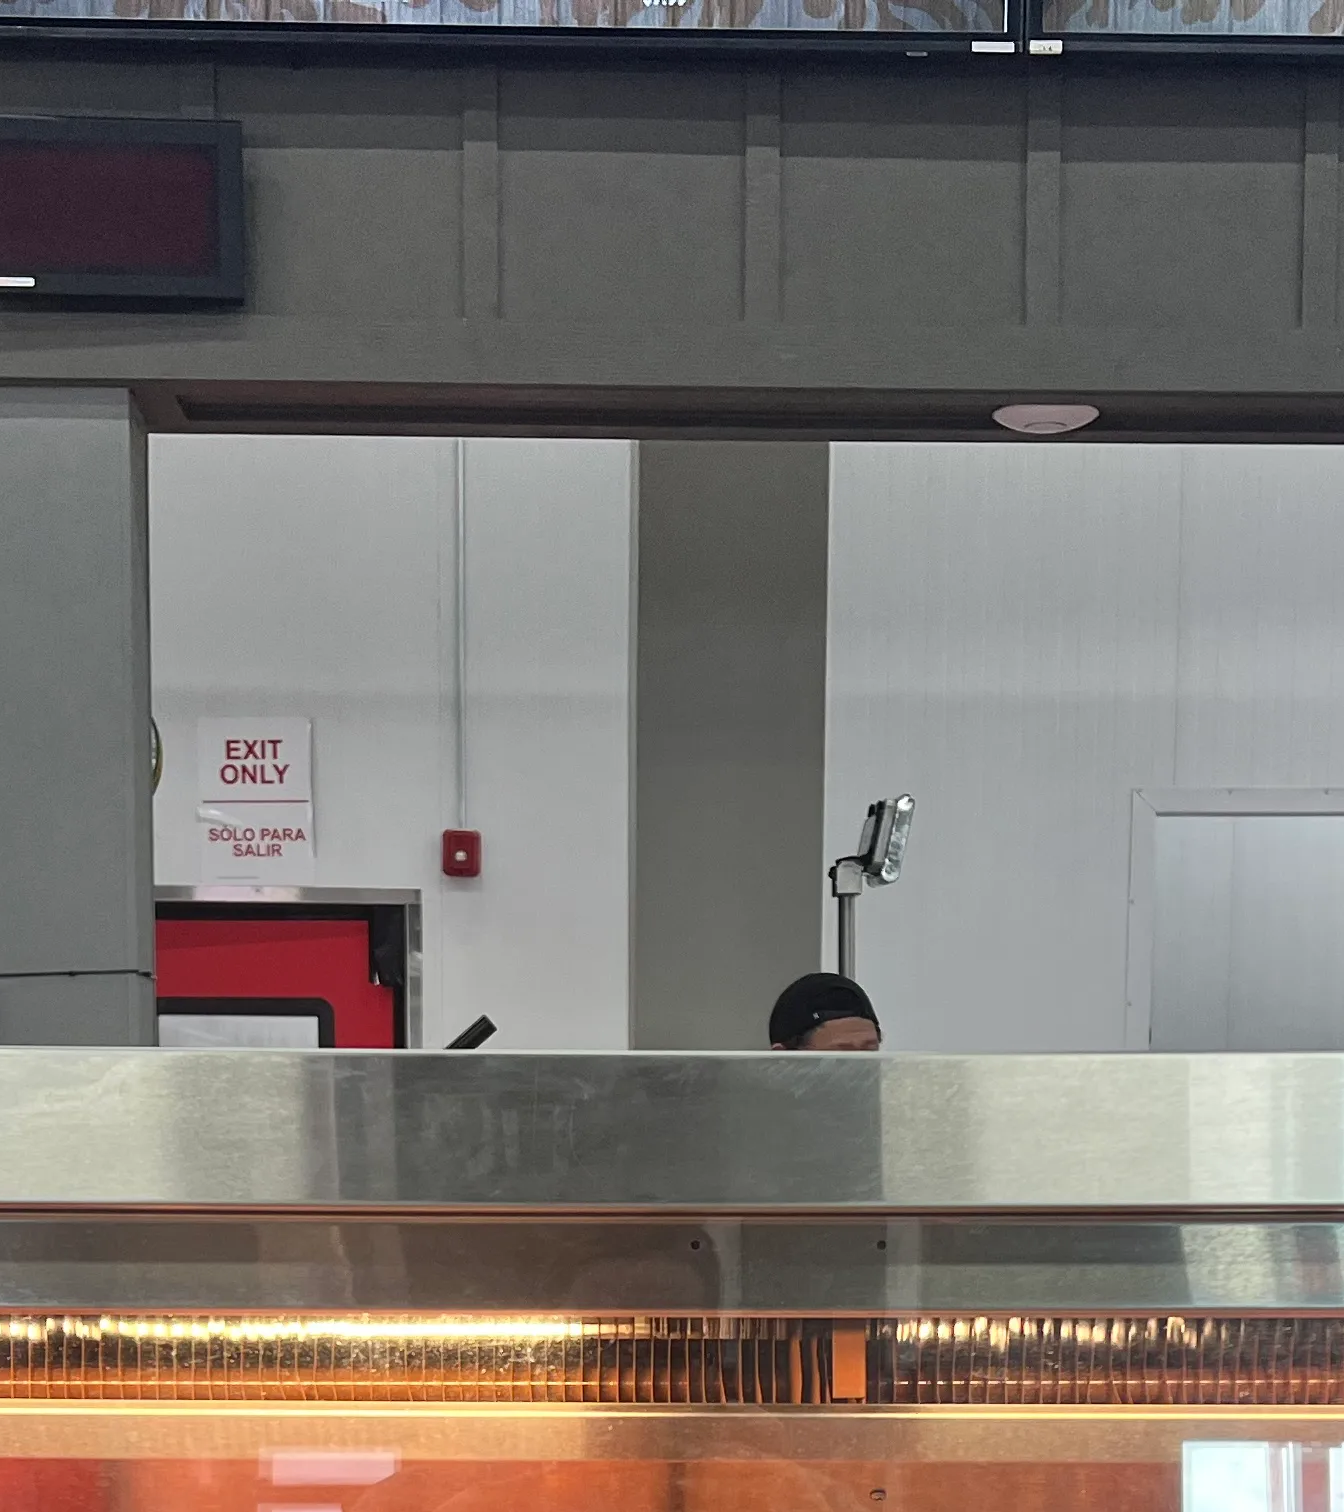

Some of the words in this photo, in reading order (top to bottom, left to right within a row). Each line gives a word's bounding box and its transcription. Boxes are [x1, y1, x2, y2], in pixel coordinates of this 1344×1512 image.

[225, 739, 283, 760] EXIT
[220, 763, 290, 784] ONLY
[259, 828, 306, 841] PARA
[233, 843, 283, 857] SALIR
